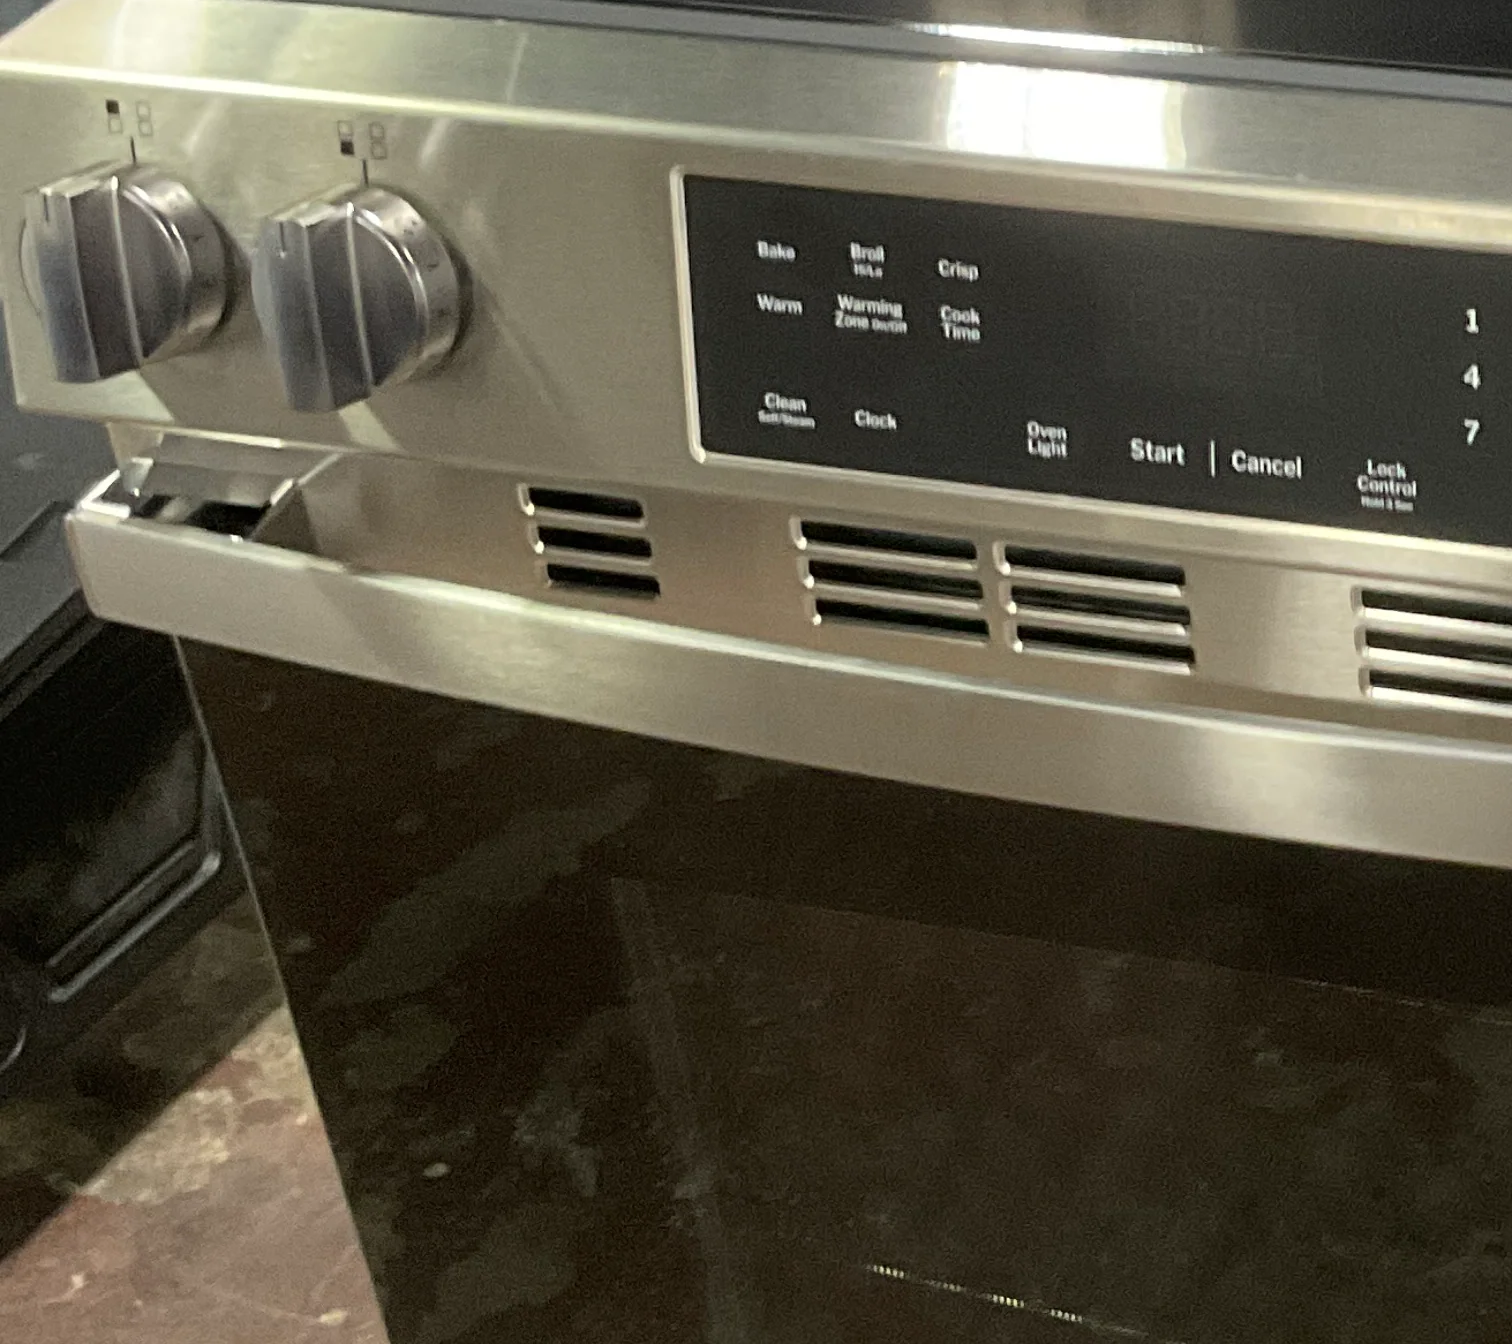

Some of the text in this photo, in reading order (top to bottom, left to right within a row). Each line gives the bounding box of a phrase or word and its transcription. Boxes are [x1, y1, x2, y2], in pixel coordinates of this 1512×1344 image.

[757, 239, 797, 263] Bake
[850, 240, 885, 264] Broil
[937, 257, 980, 283] Crisp
[756, 293, 804, 316] Warm
[836, 293, 904, 320] Warming
[940, 303, 981, 327] Cook
[834, 309, 870, 330] Zone
[1465, 308, 1480, 335] 1
[941, 323, 982, 344] Time
[1462, 363, 1482, 391] 4
[763, 391, 808, 414] Clean
[854, 408, 898, 432] Clock
[1026, 419, 1068, 441] Oven
[1463, 417, 1481, 446] 7
[1027, 437, 1068, 460] Light
[1130, 437, 1303, 481] Start Cancel
[1366, 457, 1408, 480] Lock
[1356, 473, 1418, 499] Control
